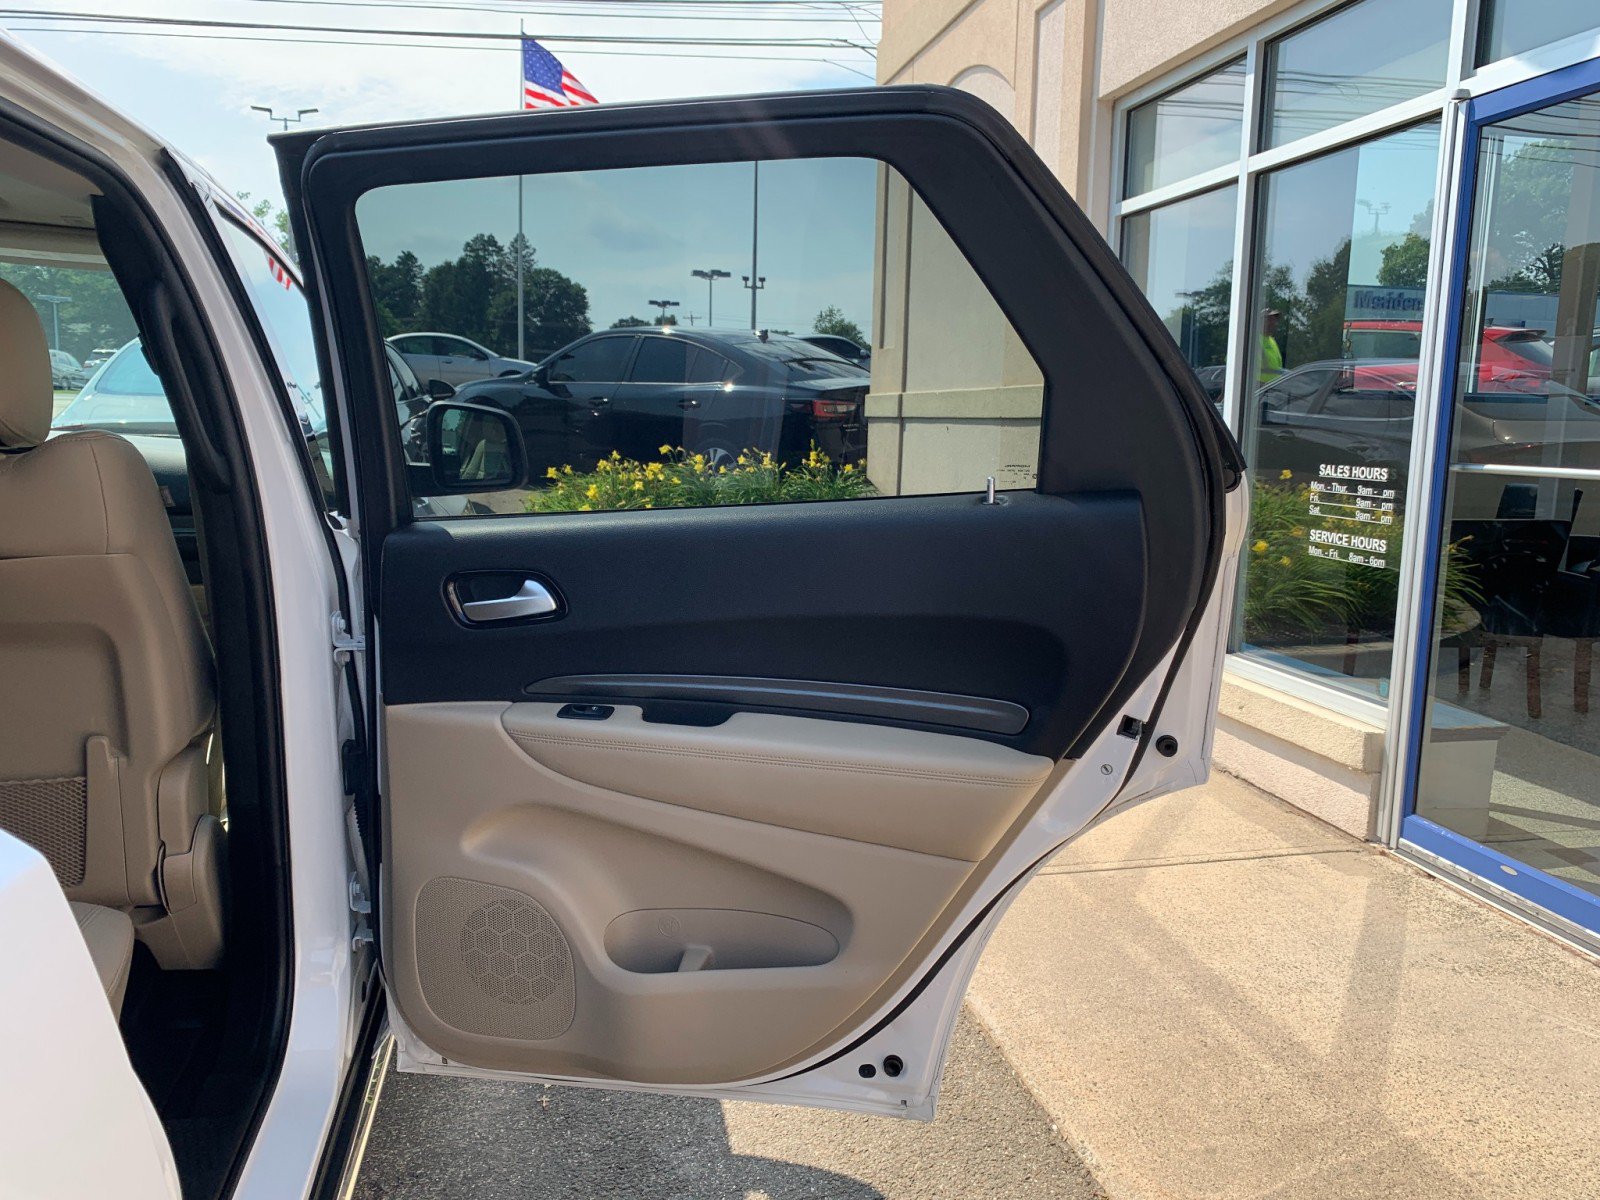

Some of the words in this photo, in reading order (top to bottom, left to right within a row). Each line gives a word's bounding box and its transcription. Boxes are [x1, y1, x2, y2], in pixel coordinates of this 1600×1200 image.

[1319, 464, 1350, 477] SALES
[1352, 466, 1388, 480] HOURS
[1310, 481, 1326, 491] Mon.
[1332, 482, 1348, 493] Thur.
[1357, 485, 1373, 495] 9am
[1383, 489, 1395, 499] pm
[1309, 492, 1320, 503] Fri.
[1356, 498, 1371, 508] 9am
[1381, 502, 1393, 511] pm
[1308, 504, 1321, 514] Sat.
[1355, 510, 1371, 520] 9am
[1380, 515, 1392, 524] pm
[1309, 529, 1350, 546] SERVICE
[1350, 535, 1387, 552] HOURS
[1308, 545, 1324, 556] Mon.
[1348, 552, 1364, 562] 8am
[1369, 556, 1385, 567] 6pm
